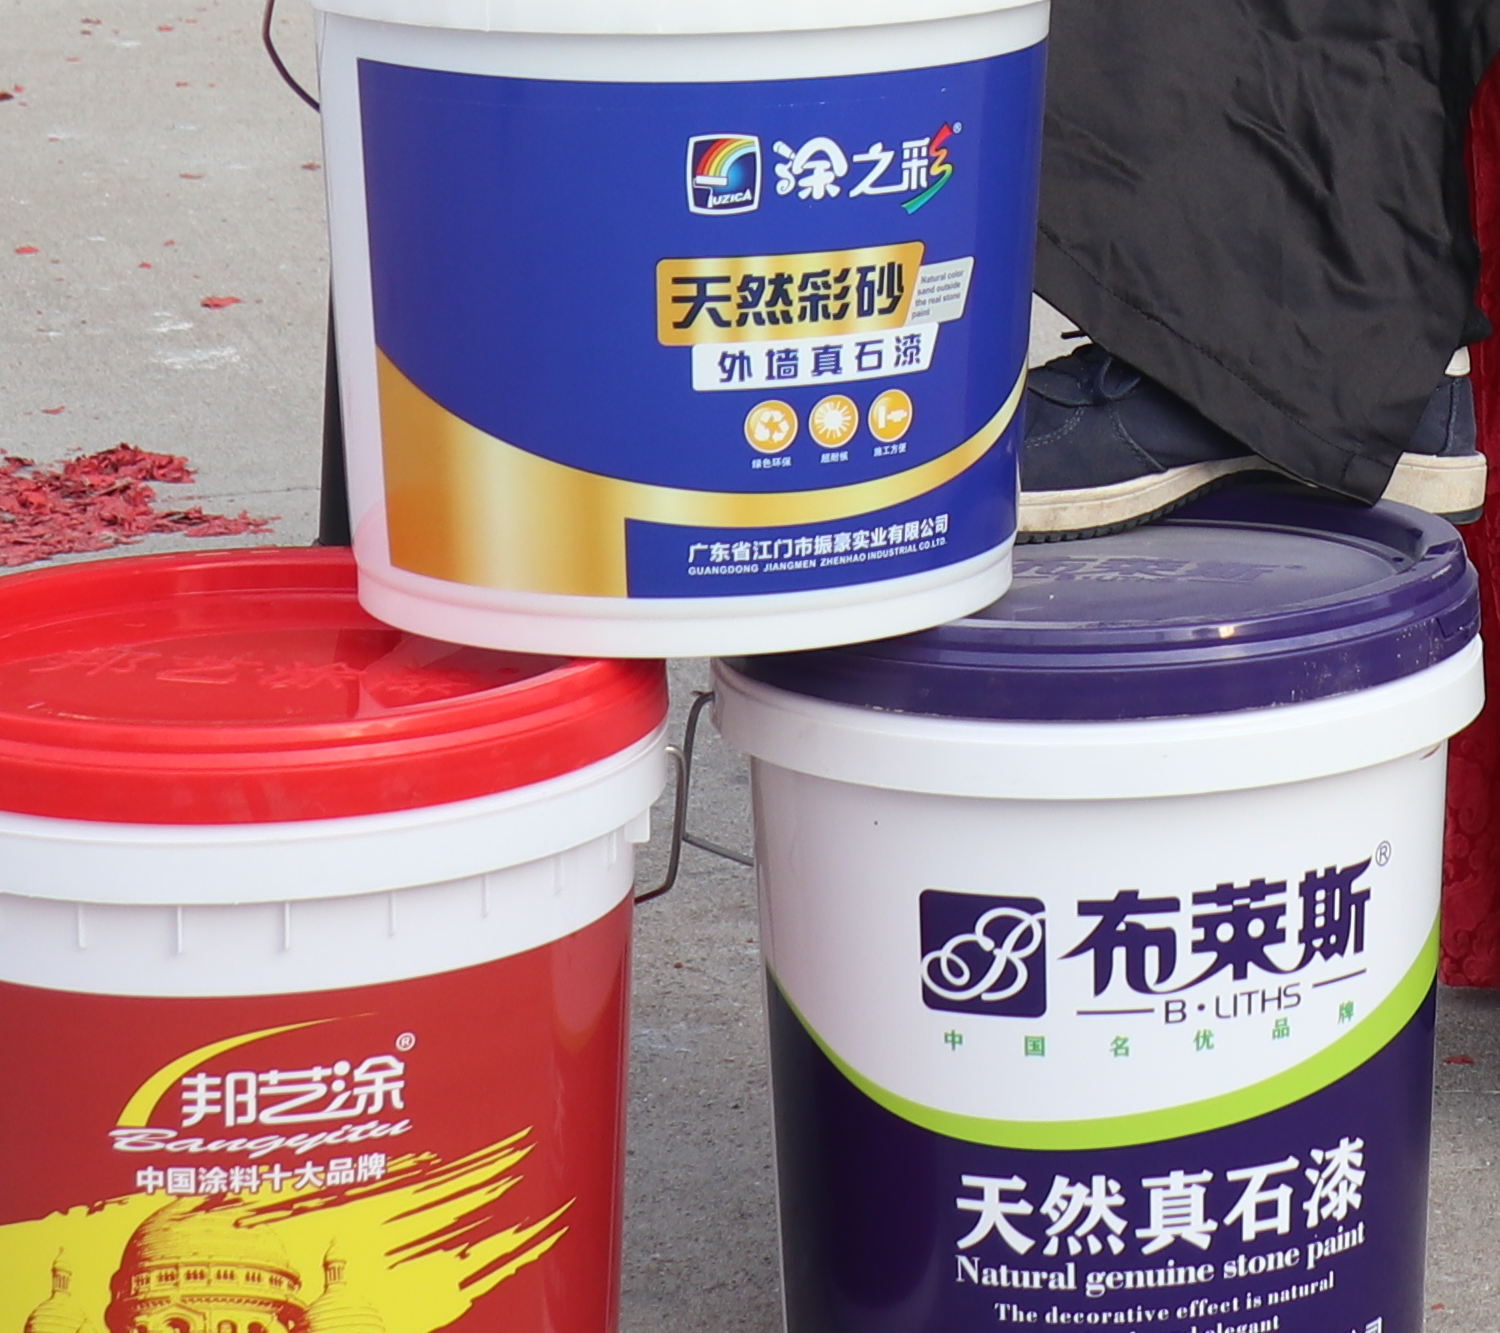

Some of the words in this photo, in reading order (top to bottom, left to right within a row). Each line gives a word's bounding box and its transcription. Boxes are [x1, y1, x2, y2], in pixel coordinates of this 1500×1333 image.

[772, 122, 954, 215] 涂之彩
[671, 261, 904, 330] 天然彩砂
[915, 299, 927, 307] the
[928, 295, 942, 304] real
[921, 273, 946, 284] Natural
[911, 308, 930, 320] paint
[717, 333, 922, 384] 外墙真石漆
[751, 456, 792, 469] 绿色环保
[873, 442, 907, 457] 施工方便
[688, 514, 949, 563] 广东省江门市振豪实业有限公司
[688, 564, 759, 576] GUANGDONG
[763, 559, 817, 573] JIANGMEN
[819, 552, 866, 568] ZHENHAO
[867, 543, 918, 561] INDUSTRIAL
[1057, 856, 1373, 999] 布莱斯
[944, 1001, 1356, 1058] 中国名优品牌
[180, 1054, 407, 1127] 邦艺涂
[108, 1118, 412, 1158] Bangyitu
[135, 1152, 387, 1196] 中国涂料十大品牌
[955, 1137, 1366, 1256] 天然真石漆
[955, 1253, 1077, 1291] Natural
[1085, 1259, 1215, 1298] genuine
[1222, 1244, 1301, 1279] stone
[1306, 1221, 1366, 1270] paint
[994, 1302, 1038, 1324] The
[1044, 1305, 1169, 1325] decorative
[1176, 1296, 1240, 1319] effect
[1246, 1292, 1262, 1310] is
[1267, 1271, 1336, 1306] natural
